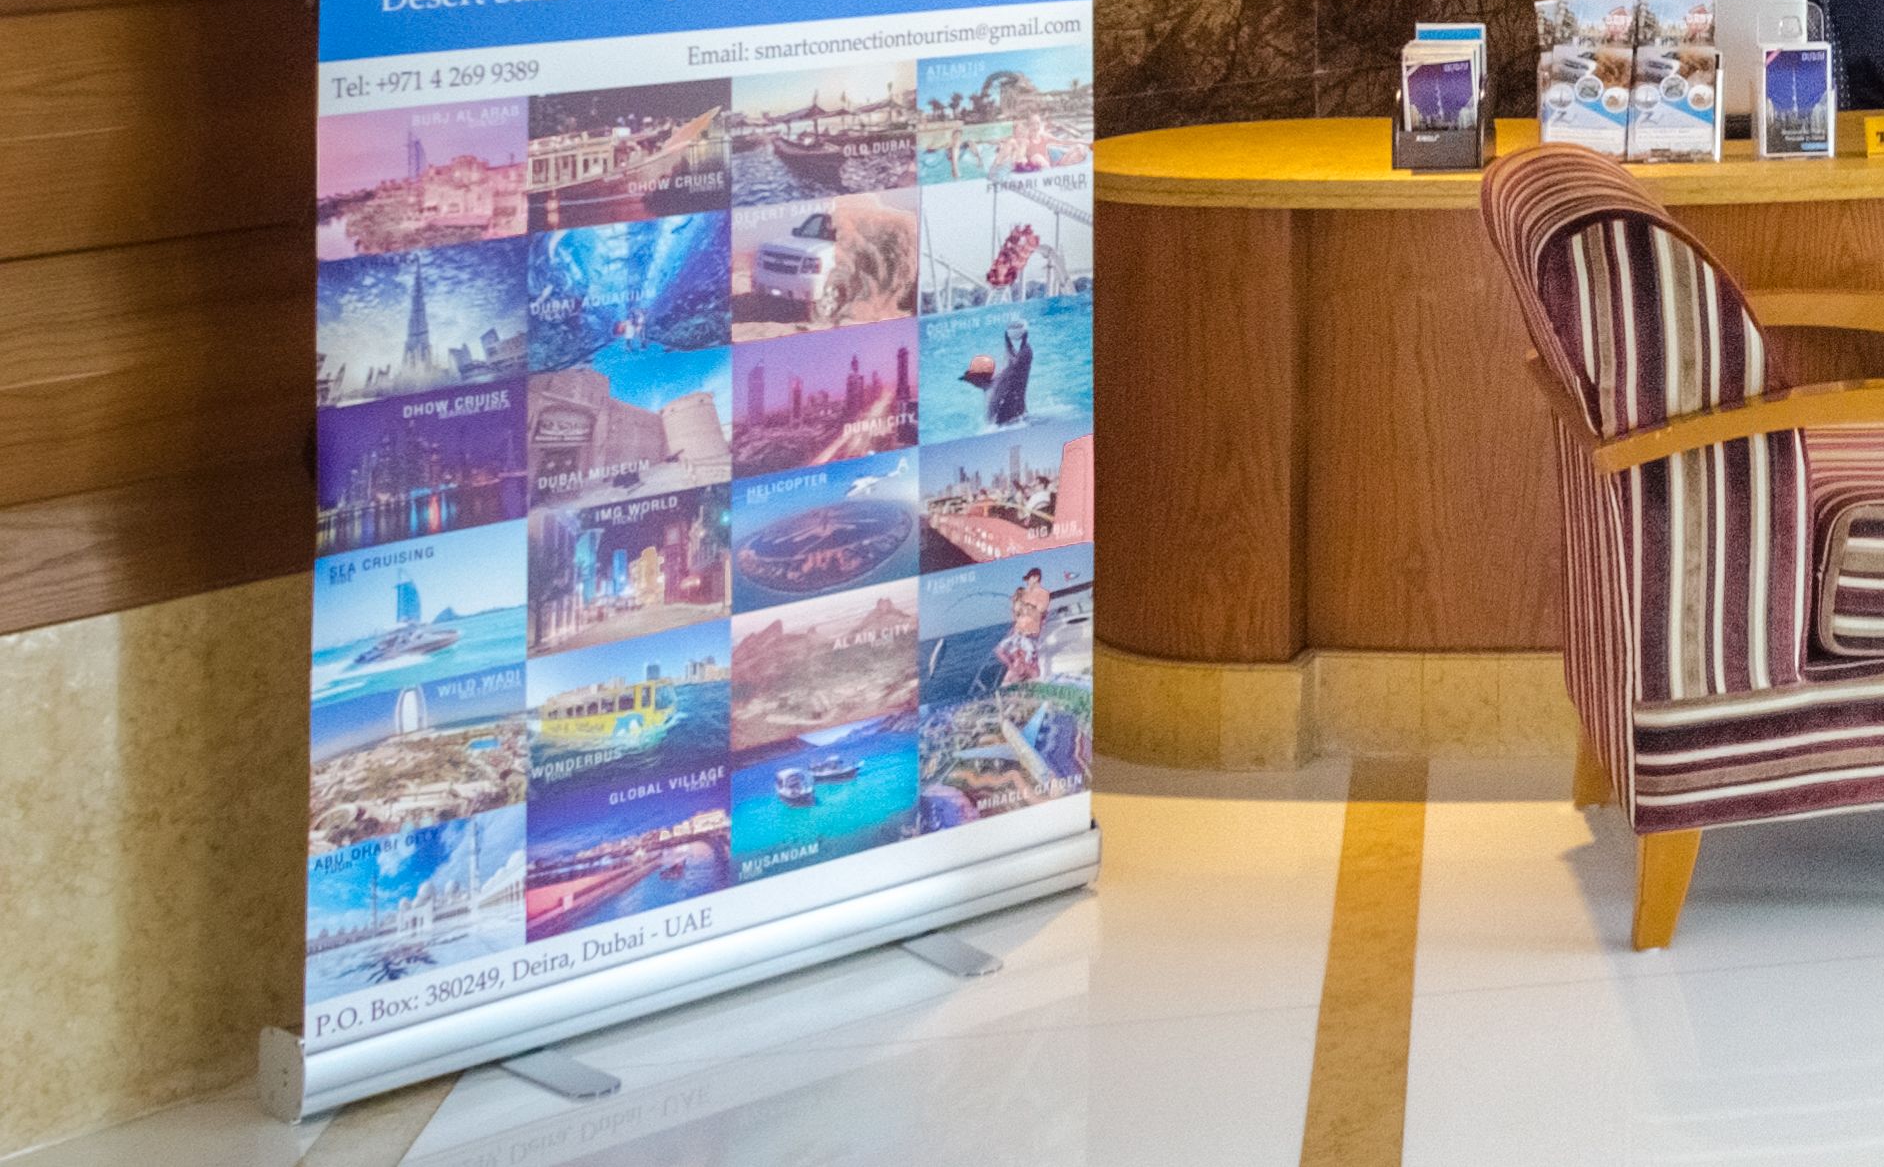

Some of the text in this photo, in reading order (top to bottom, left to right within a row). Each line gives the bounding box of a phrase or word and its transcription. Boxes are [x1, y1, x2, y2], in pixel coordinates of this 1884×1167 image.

[687, 16, 1082, 67] Email: smartconnectiontourism@gmail.com
[332, 59, 540, 99] Tel: +971 4 269 9389
[872, 138, 911, 154] DUBAI
[628, 177, 670, 194] DHOW
[675, 171, 725, 189] CRUISE
[1043, 173, 1086, 187] WORLD
[529, 298, 576, 316] DUBAI
[403, 399, 449, 419] DHOW
[454, 389, 509, 410] CRUISE
[538, 470, 582, 490] DUBAI
[589, 459, 649, 482] MUSEUM
[746, 471, 828, 496] HELICOPTER
[595, 495, 678, 523] IMG WORLD
[329, 546, 434, 578] SEA CRUISING
[531, 747, 622, 779] WONDERBUS
[609, 765, 725, 805] GLOBAL VILLAGE
[313, 852, 343, 871] ABU
[351, 838, 398, 861] DHABI
[742, 842, 819, 869] MUSANDAM
[315, 1010, 363, 1036] P.O.
[370, 994, 418, 1021] Box:
[425, 969, 505, 1008] 380249,
[511, 947, 575, 981] Deira,
[582, 930, 645, 963] Dubai
[665, 906, 713, 939] UAE
